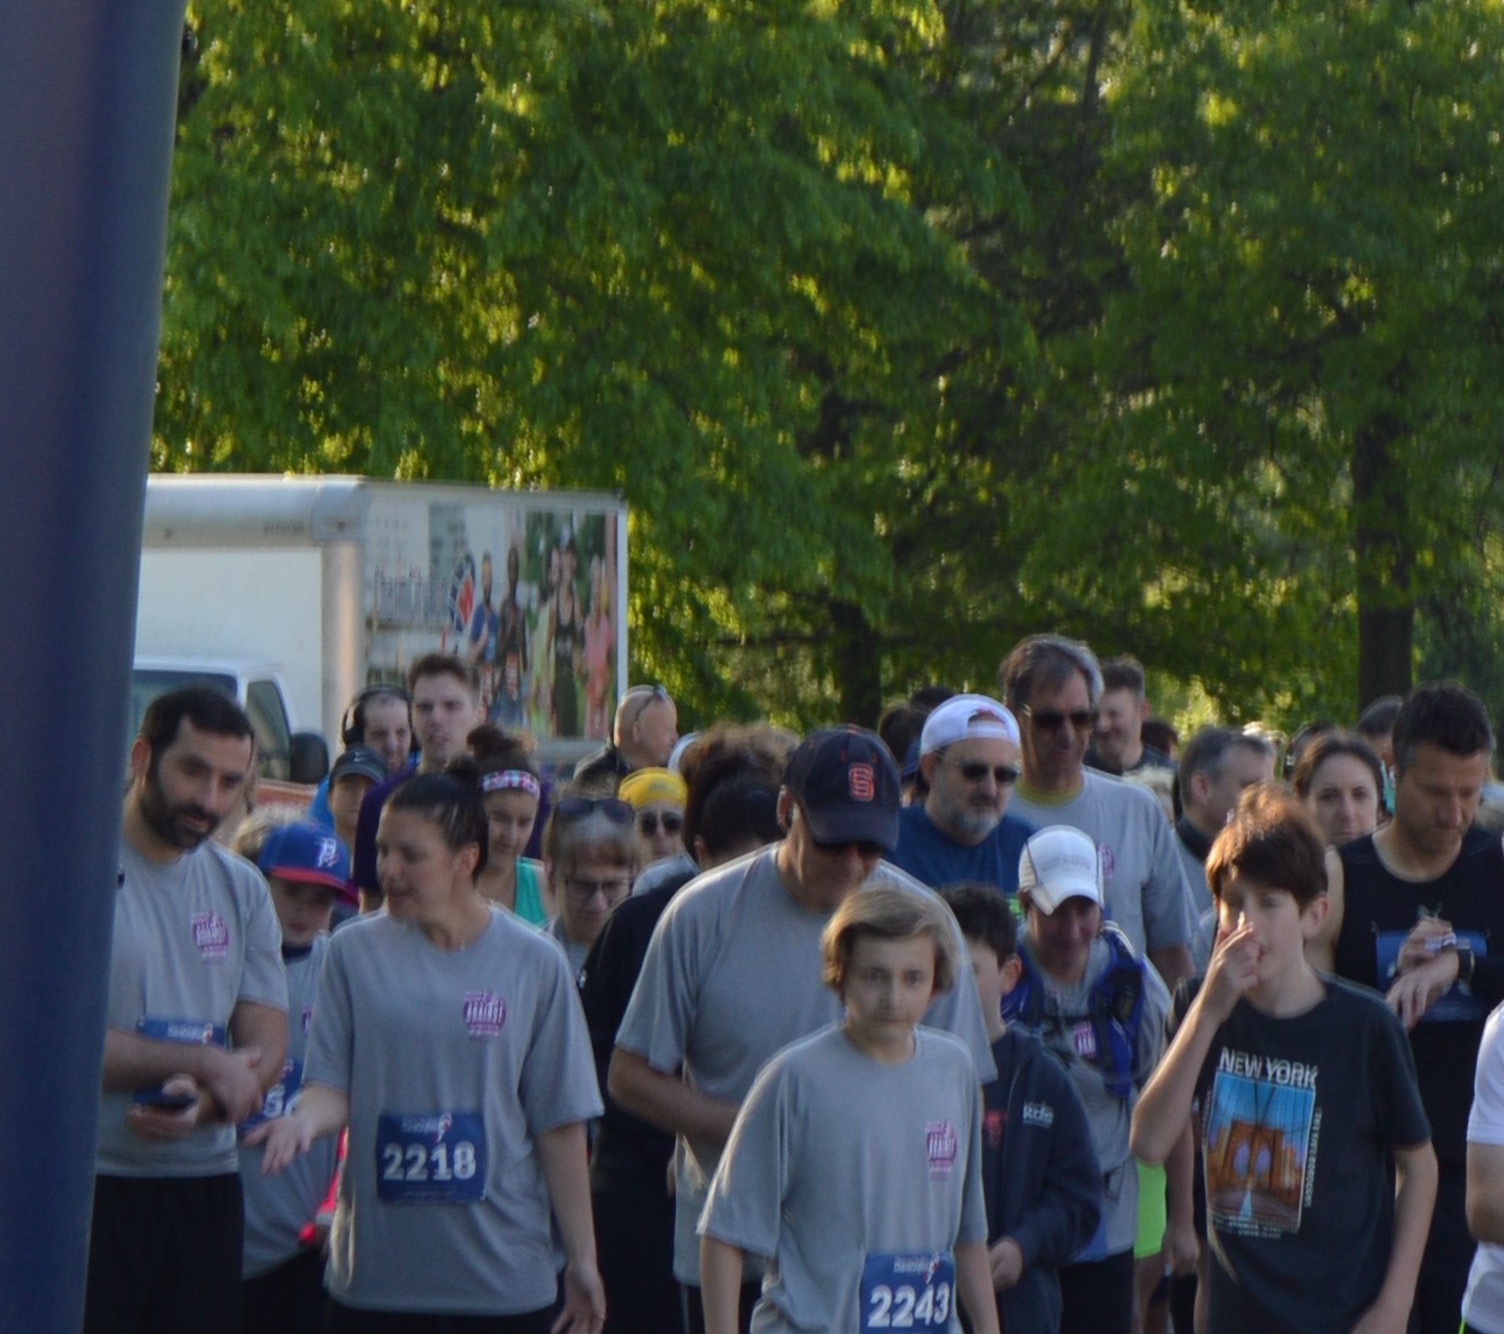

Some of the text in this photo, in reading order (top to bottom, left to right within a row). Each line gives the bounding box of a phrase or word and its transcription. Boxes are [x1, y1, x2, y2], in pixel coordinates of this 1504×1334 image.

[1219, 1047, 1319, 1089] NEW YORK
[383, 1141, 477, 1182] 2218
[867, 1281, 950, 1328] 2243
